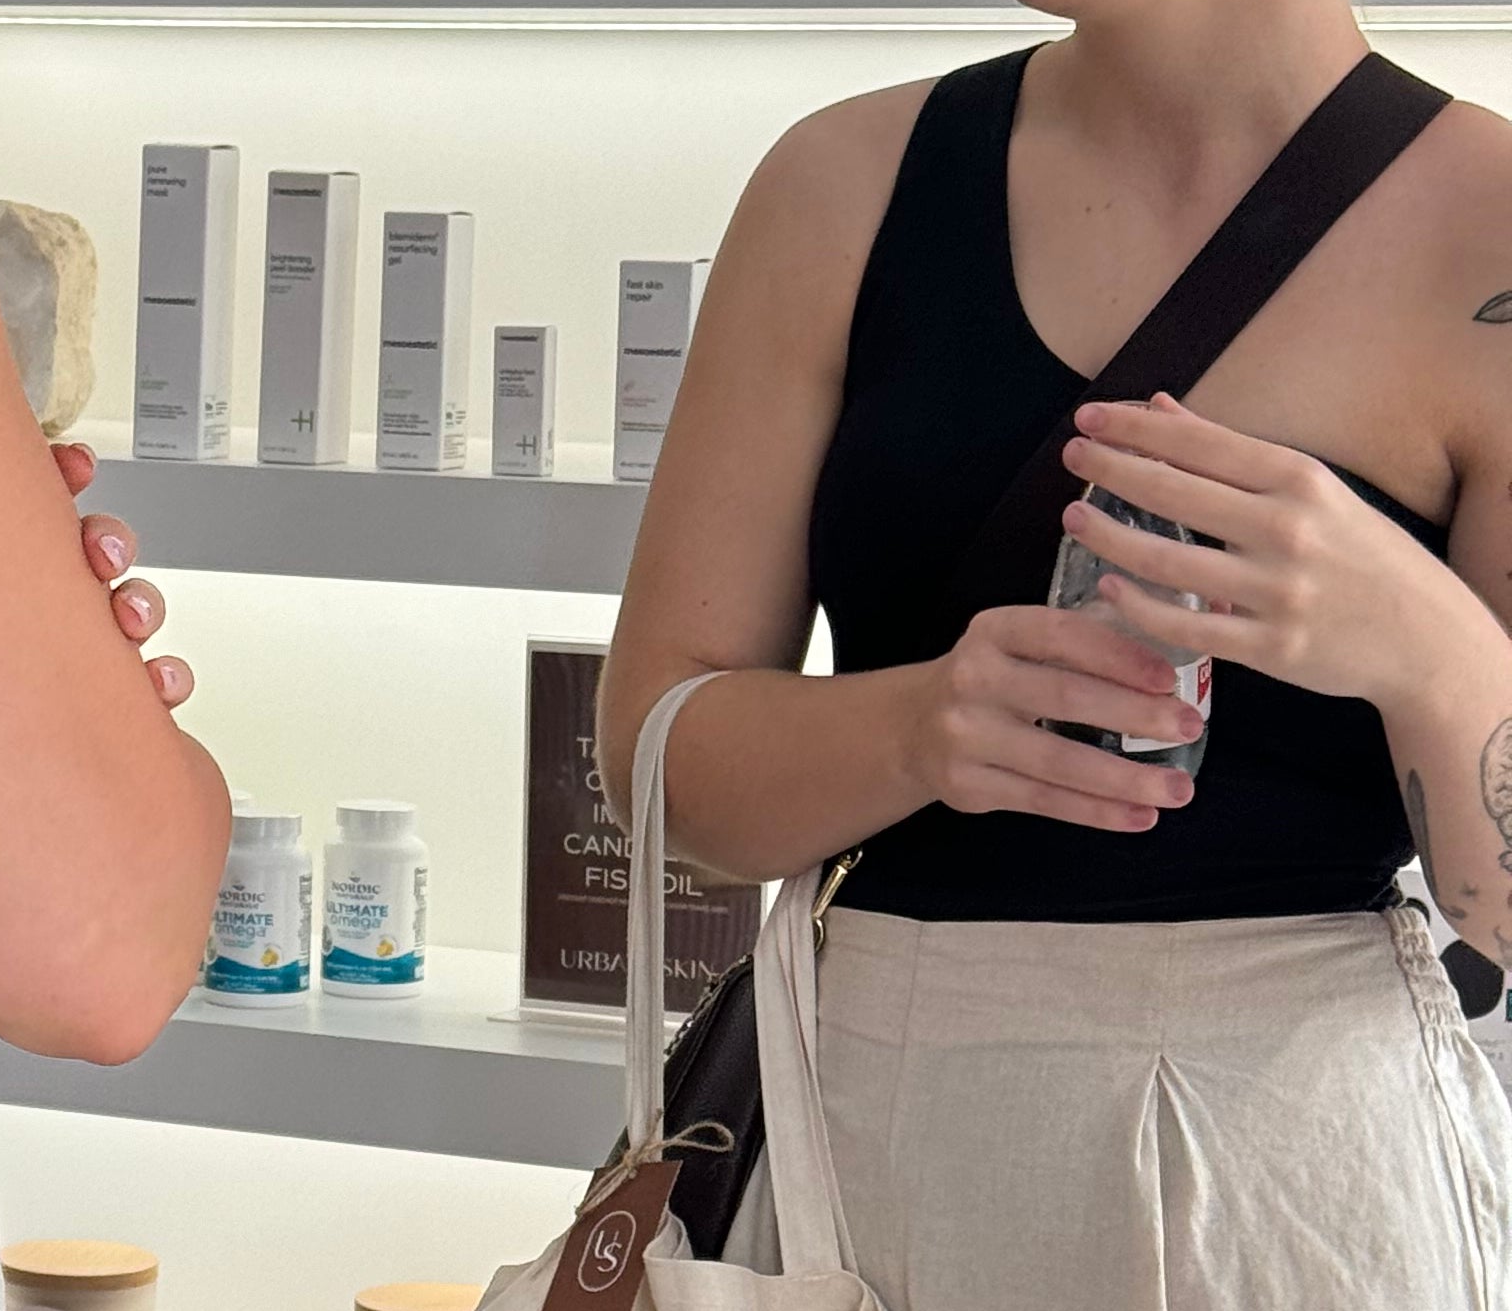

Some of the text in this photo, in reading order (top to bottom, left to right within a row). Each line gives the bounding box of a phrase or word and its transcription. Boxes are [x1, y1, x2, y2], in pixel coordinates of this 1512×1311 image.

[584, 866, 629, 890] FIS
[332, 881, 381, 895] NORDIC
[215, 911, 274, 927] LTIMATE
[330, 915, 382, 930] omega
[560, 948, 628, 973] URBA
